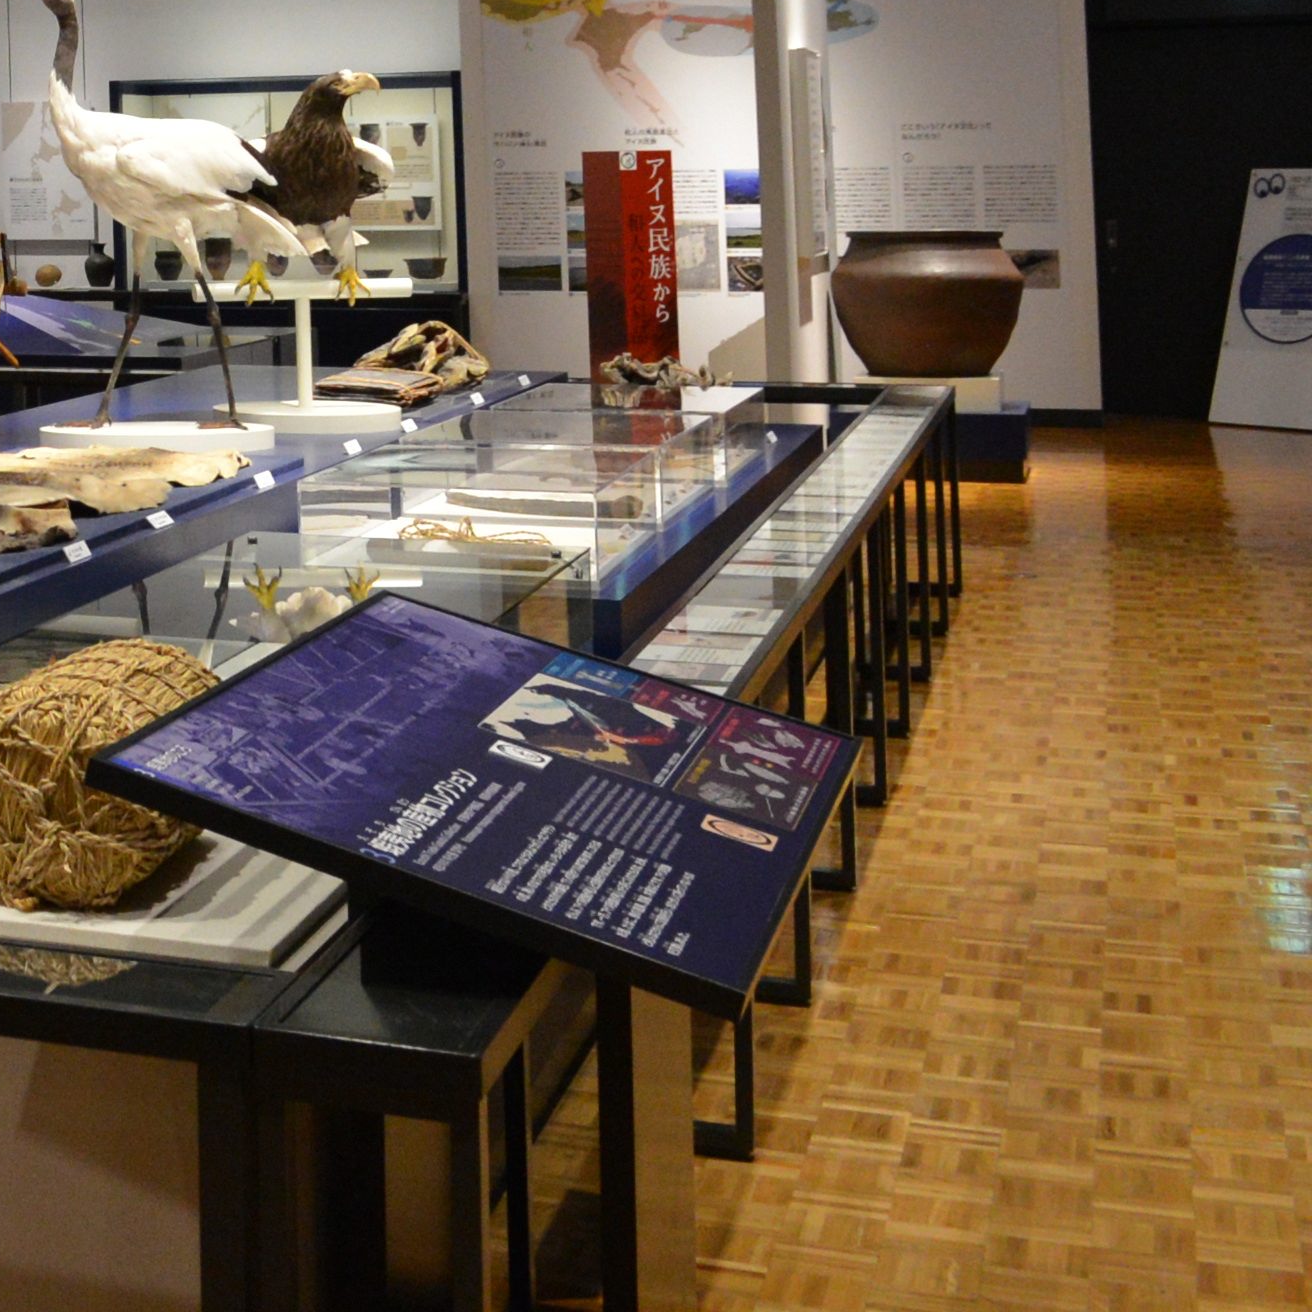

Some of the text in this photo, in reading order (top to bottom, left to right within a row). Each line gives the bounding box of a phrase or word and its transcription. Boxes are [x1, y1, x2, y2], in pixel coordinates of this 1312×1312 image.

[645, 158, 672, 324] アイヌ民族から
[368, 768, 477, 857] 蝦夷地の産物コレクション
